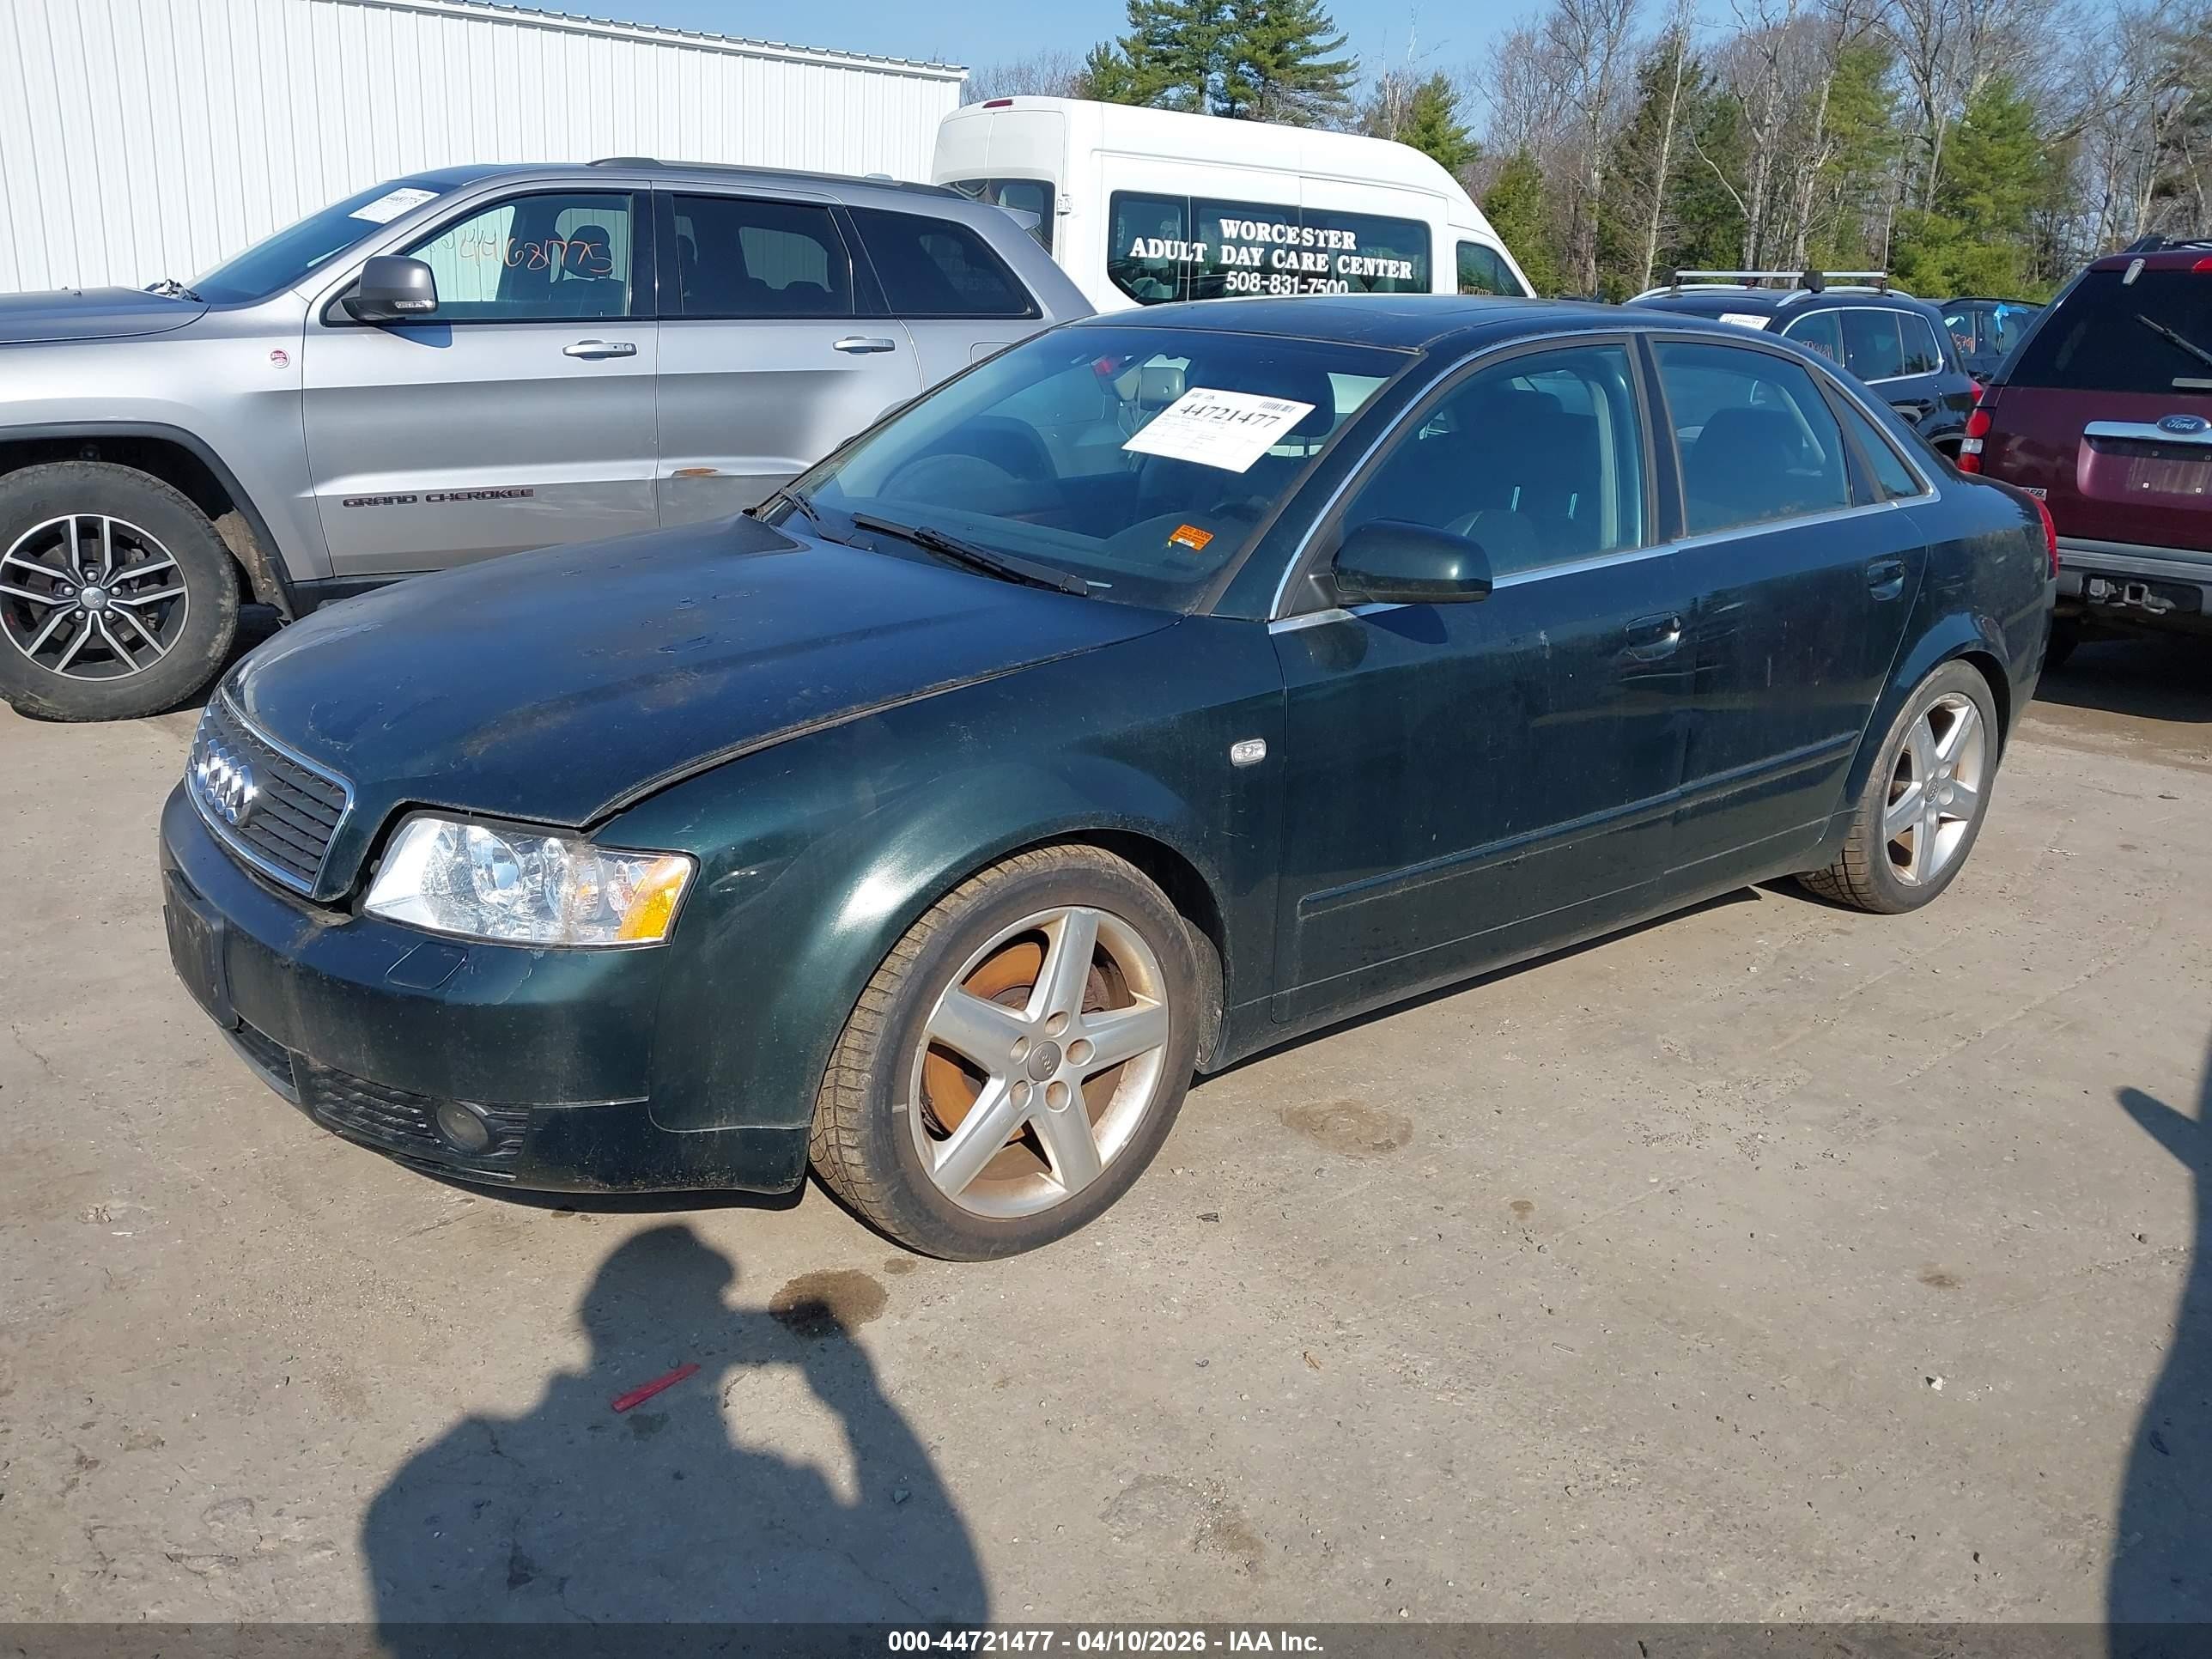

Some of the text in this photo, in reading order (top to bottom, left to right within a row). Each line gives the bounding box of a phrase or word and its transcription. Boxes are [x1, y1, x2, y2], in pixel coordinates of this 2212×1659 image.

[1219, 218, 1357, 251] WORCESTER
[1129, 236, 1413, 280] ADULT DAY CARE CENTER
[1225, 270, 1349, 295] 508-831-7500
[1180, 402, 1282, 428] 44721477
[2166, 417, 2197, 429] Ford
[343, 488, 535, 508] GRAND CHEROKEE
